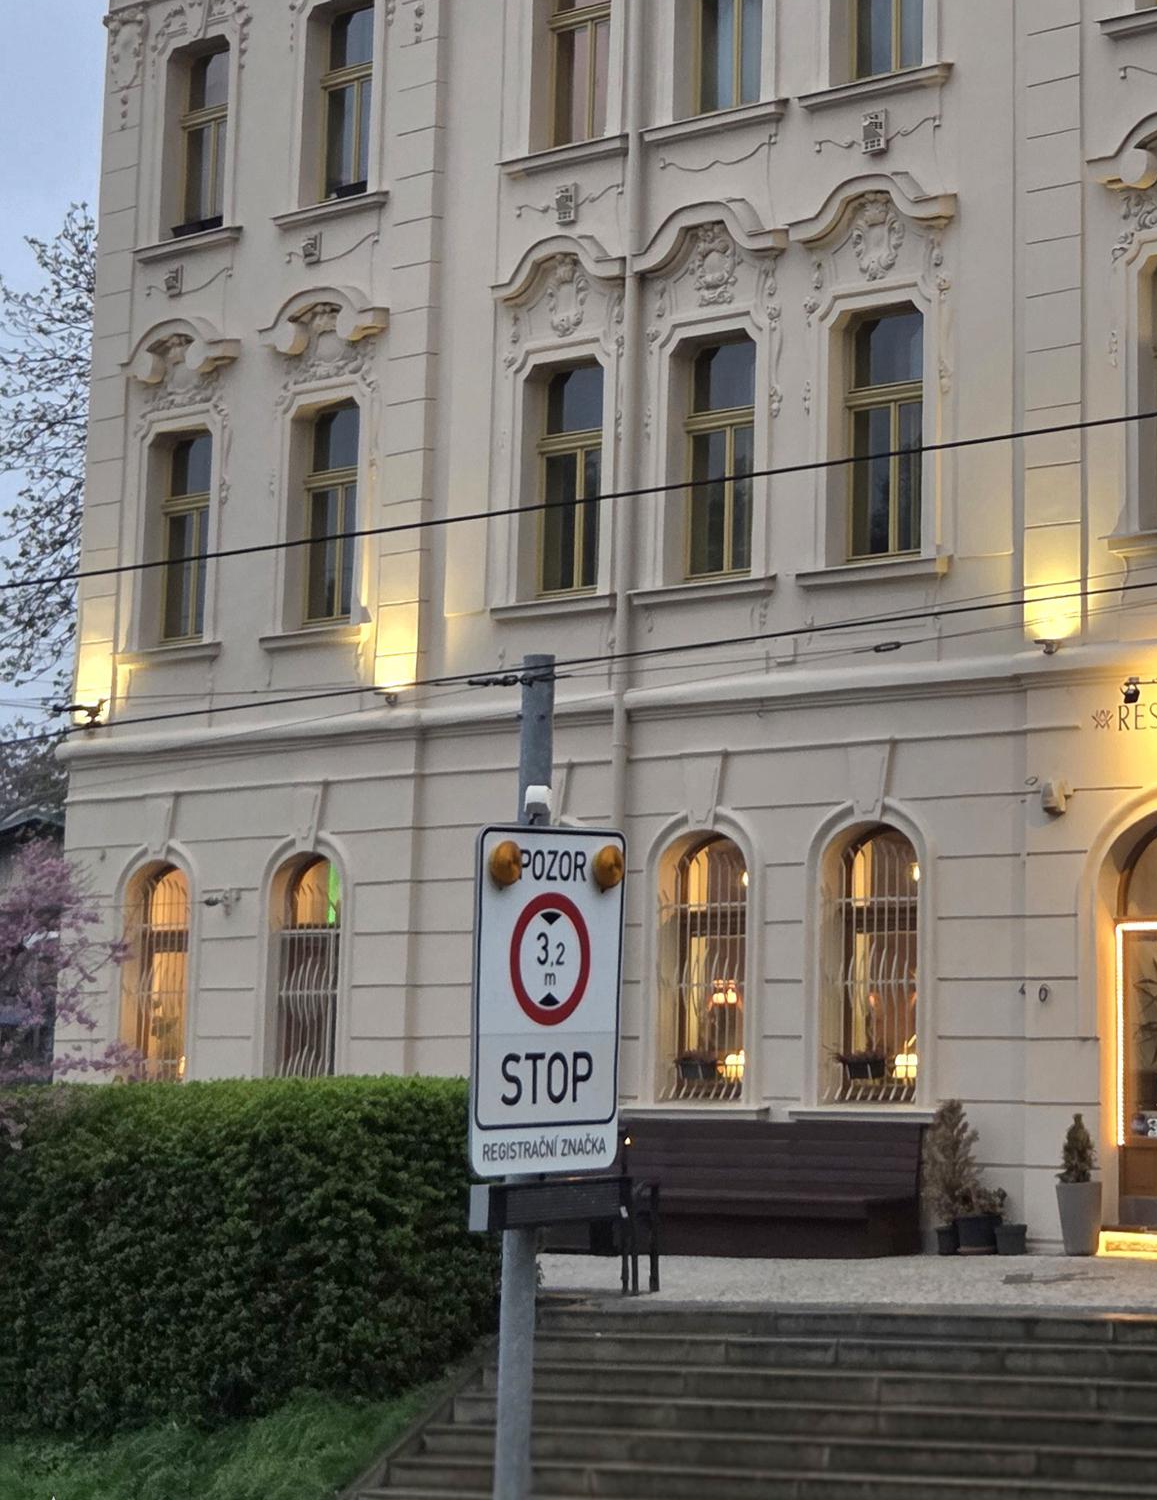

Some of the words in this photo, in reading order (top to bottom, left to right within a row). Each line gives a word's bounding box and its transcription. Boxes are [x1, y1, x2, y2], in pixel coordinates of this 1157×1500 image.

[520, 849, 588, 882] POZOR
[536, 932, 566, 967] 3,2
[544, 972, 557, 986] m
[501, 1051, 593, 1106] STOP
[482, 1135, 559, 1161] REGISTRAČNÍ
[561, 1133, 607, 1157] ZNAČKA
